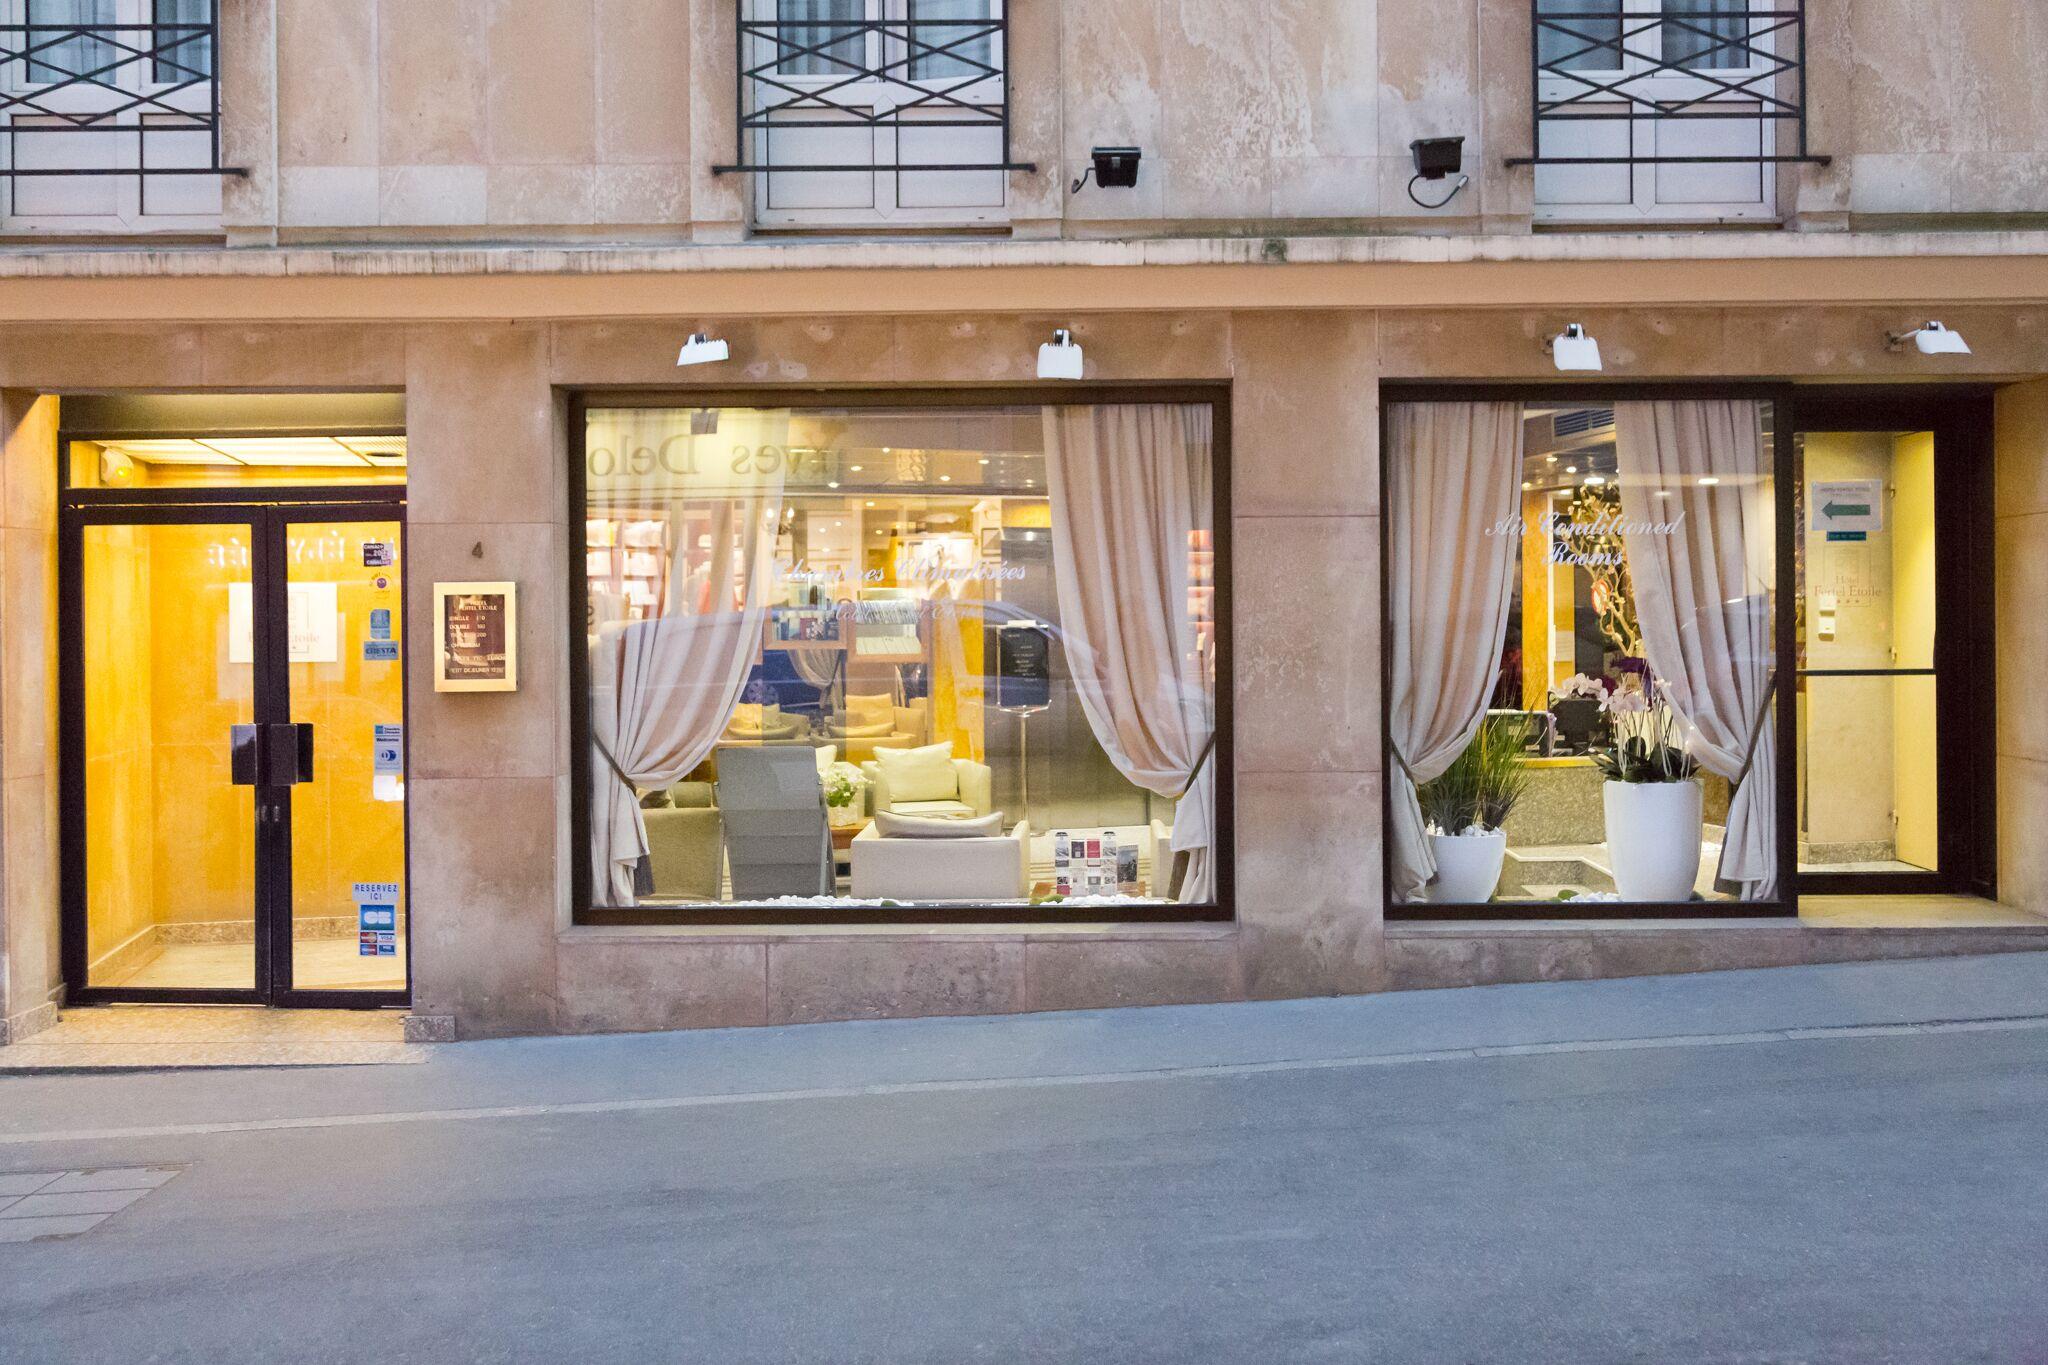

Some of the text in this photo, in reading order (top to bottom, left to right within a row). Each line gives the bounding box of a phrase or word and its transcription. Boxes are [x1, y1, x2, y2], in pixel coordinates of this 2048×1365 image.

[1485, 511, 1685, 536] Air Conditioned
[471, 541, 483, 559] 4
[1542, 542, 1623, 565] Rooms
[354, 884, 398, 892] RESERVEZ
